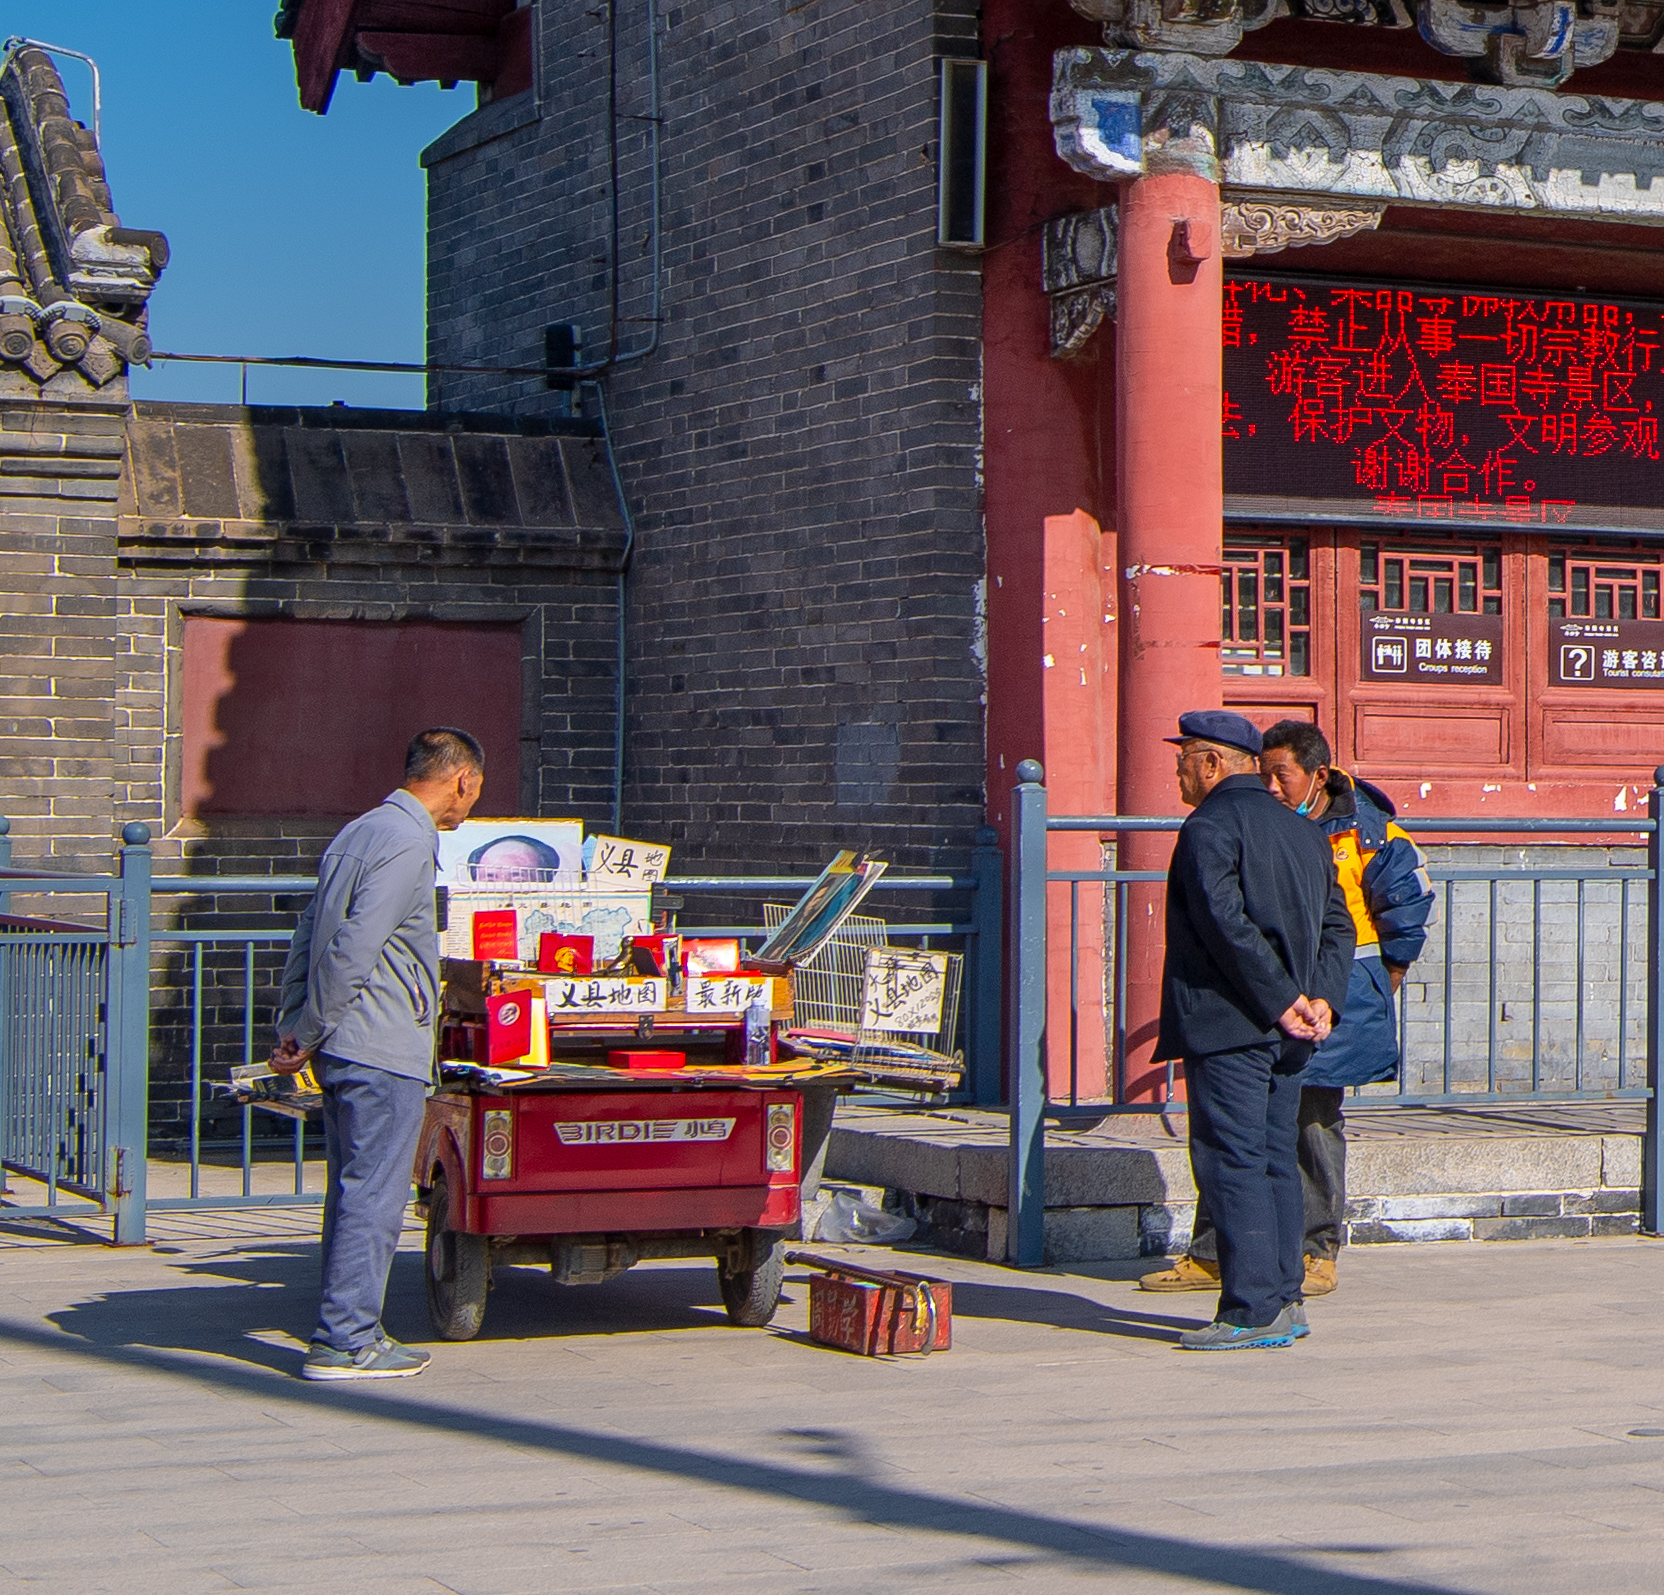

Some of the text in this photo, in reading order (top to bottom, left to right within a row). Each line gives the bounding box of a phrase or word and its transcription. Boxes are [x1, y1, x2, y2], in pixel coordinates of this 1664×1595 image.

[1415, 638, 1493, 661] 团体接待
[1602, 668, 1630, 678] Tourist
[595, 842, 640, 878] 义县
[555, 980, 658, 1009] 义县地图
[694, 979, 765, 1009] 最新版
[557, 1120, 678, 1142] BIRDIE
